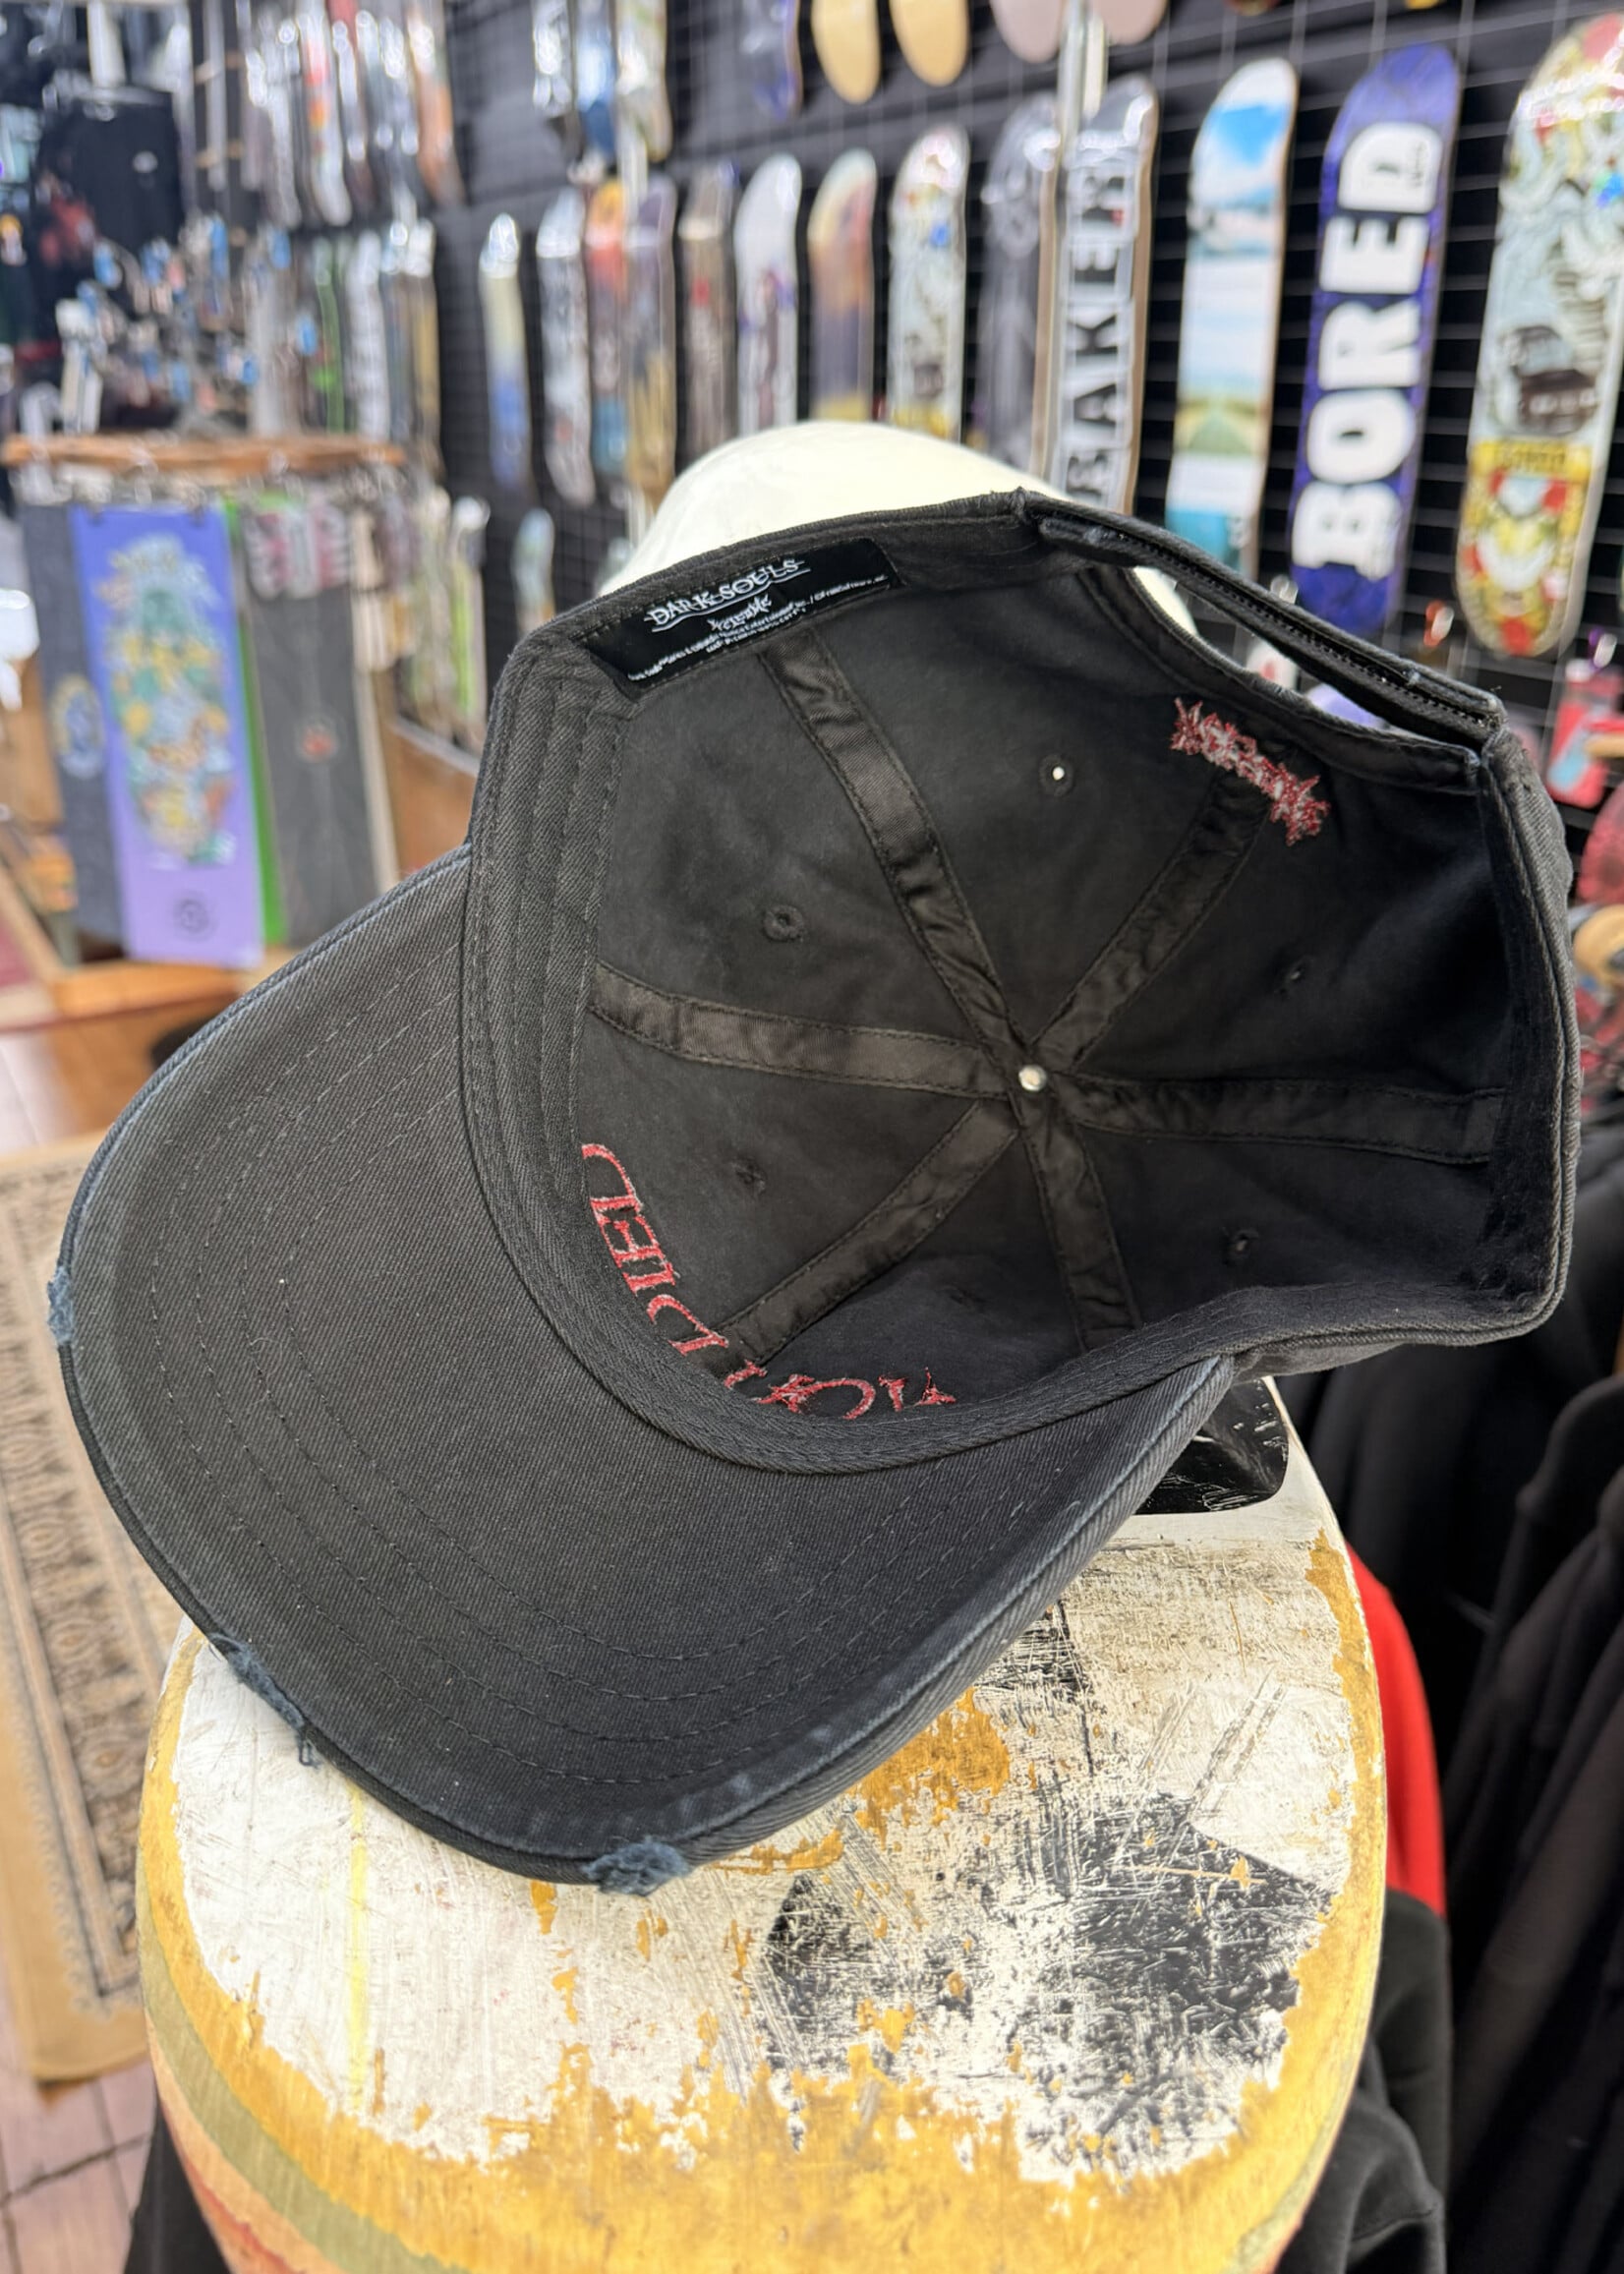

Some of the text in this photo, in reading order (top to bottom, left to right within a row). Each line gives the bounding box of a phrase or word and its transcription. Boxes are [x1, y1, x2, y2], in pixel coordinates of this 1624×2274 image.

[1292, 123, 1442, 580] BORED
[645, 592, 724, 626] DARK
[719, 557, 804, 602] SOULS
